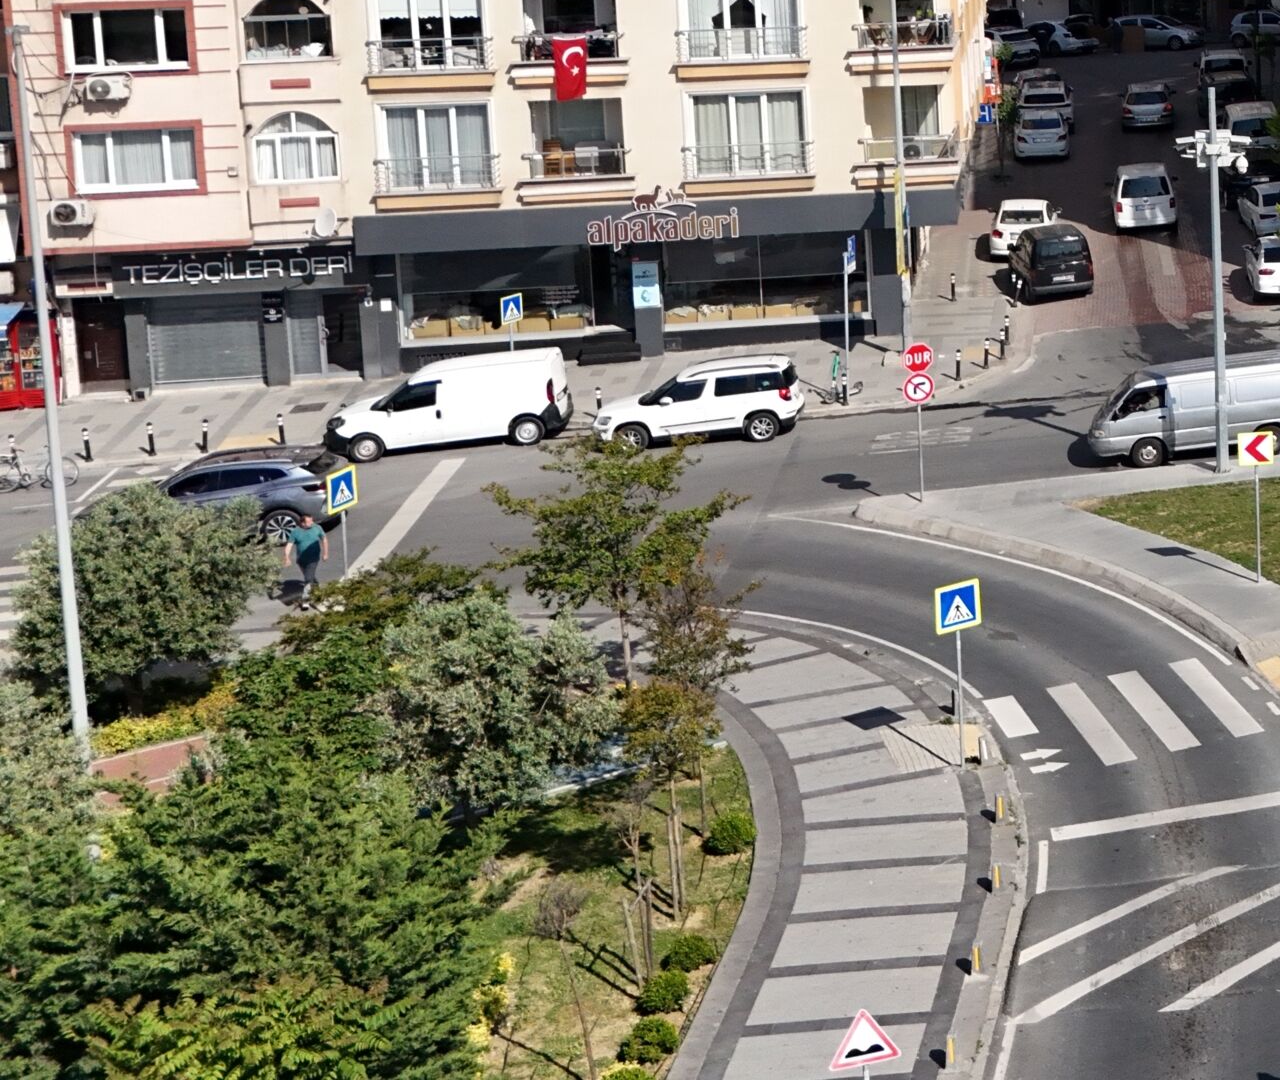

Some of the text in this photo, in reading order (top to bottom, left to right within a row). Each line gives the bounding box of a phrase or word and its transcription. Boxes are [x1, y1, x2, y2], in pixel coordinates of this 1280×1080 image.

[587, 206, 740, 252] alpakaderi
[122, 251, 353, 285] TEZİŞÇİLER DERİ
[905, 351, 931, 366] DUR
